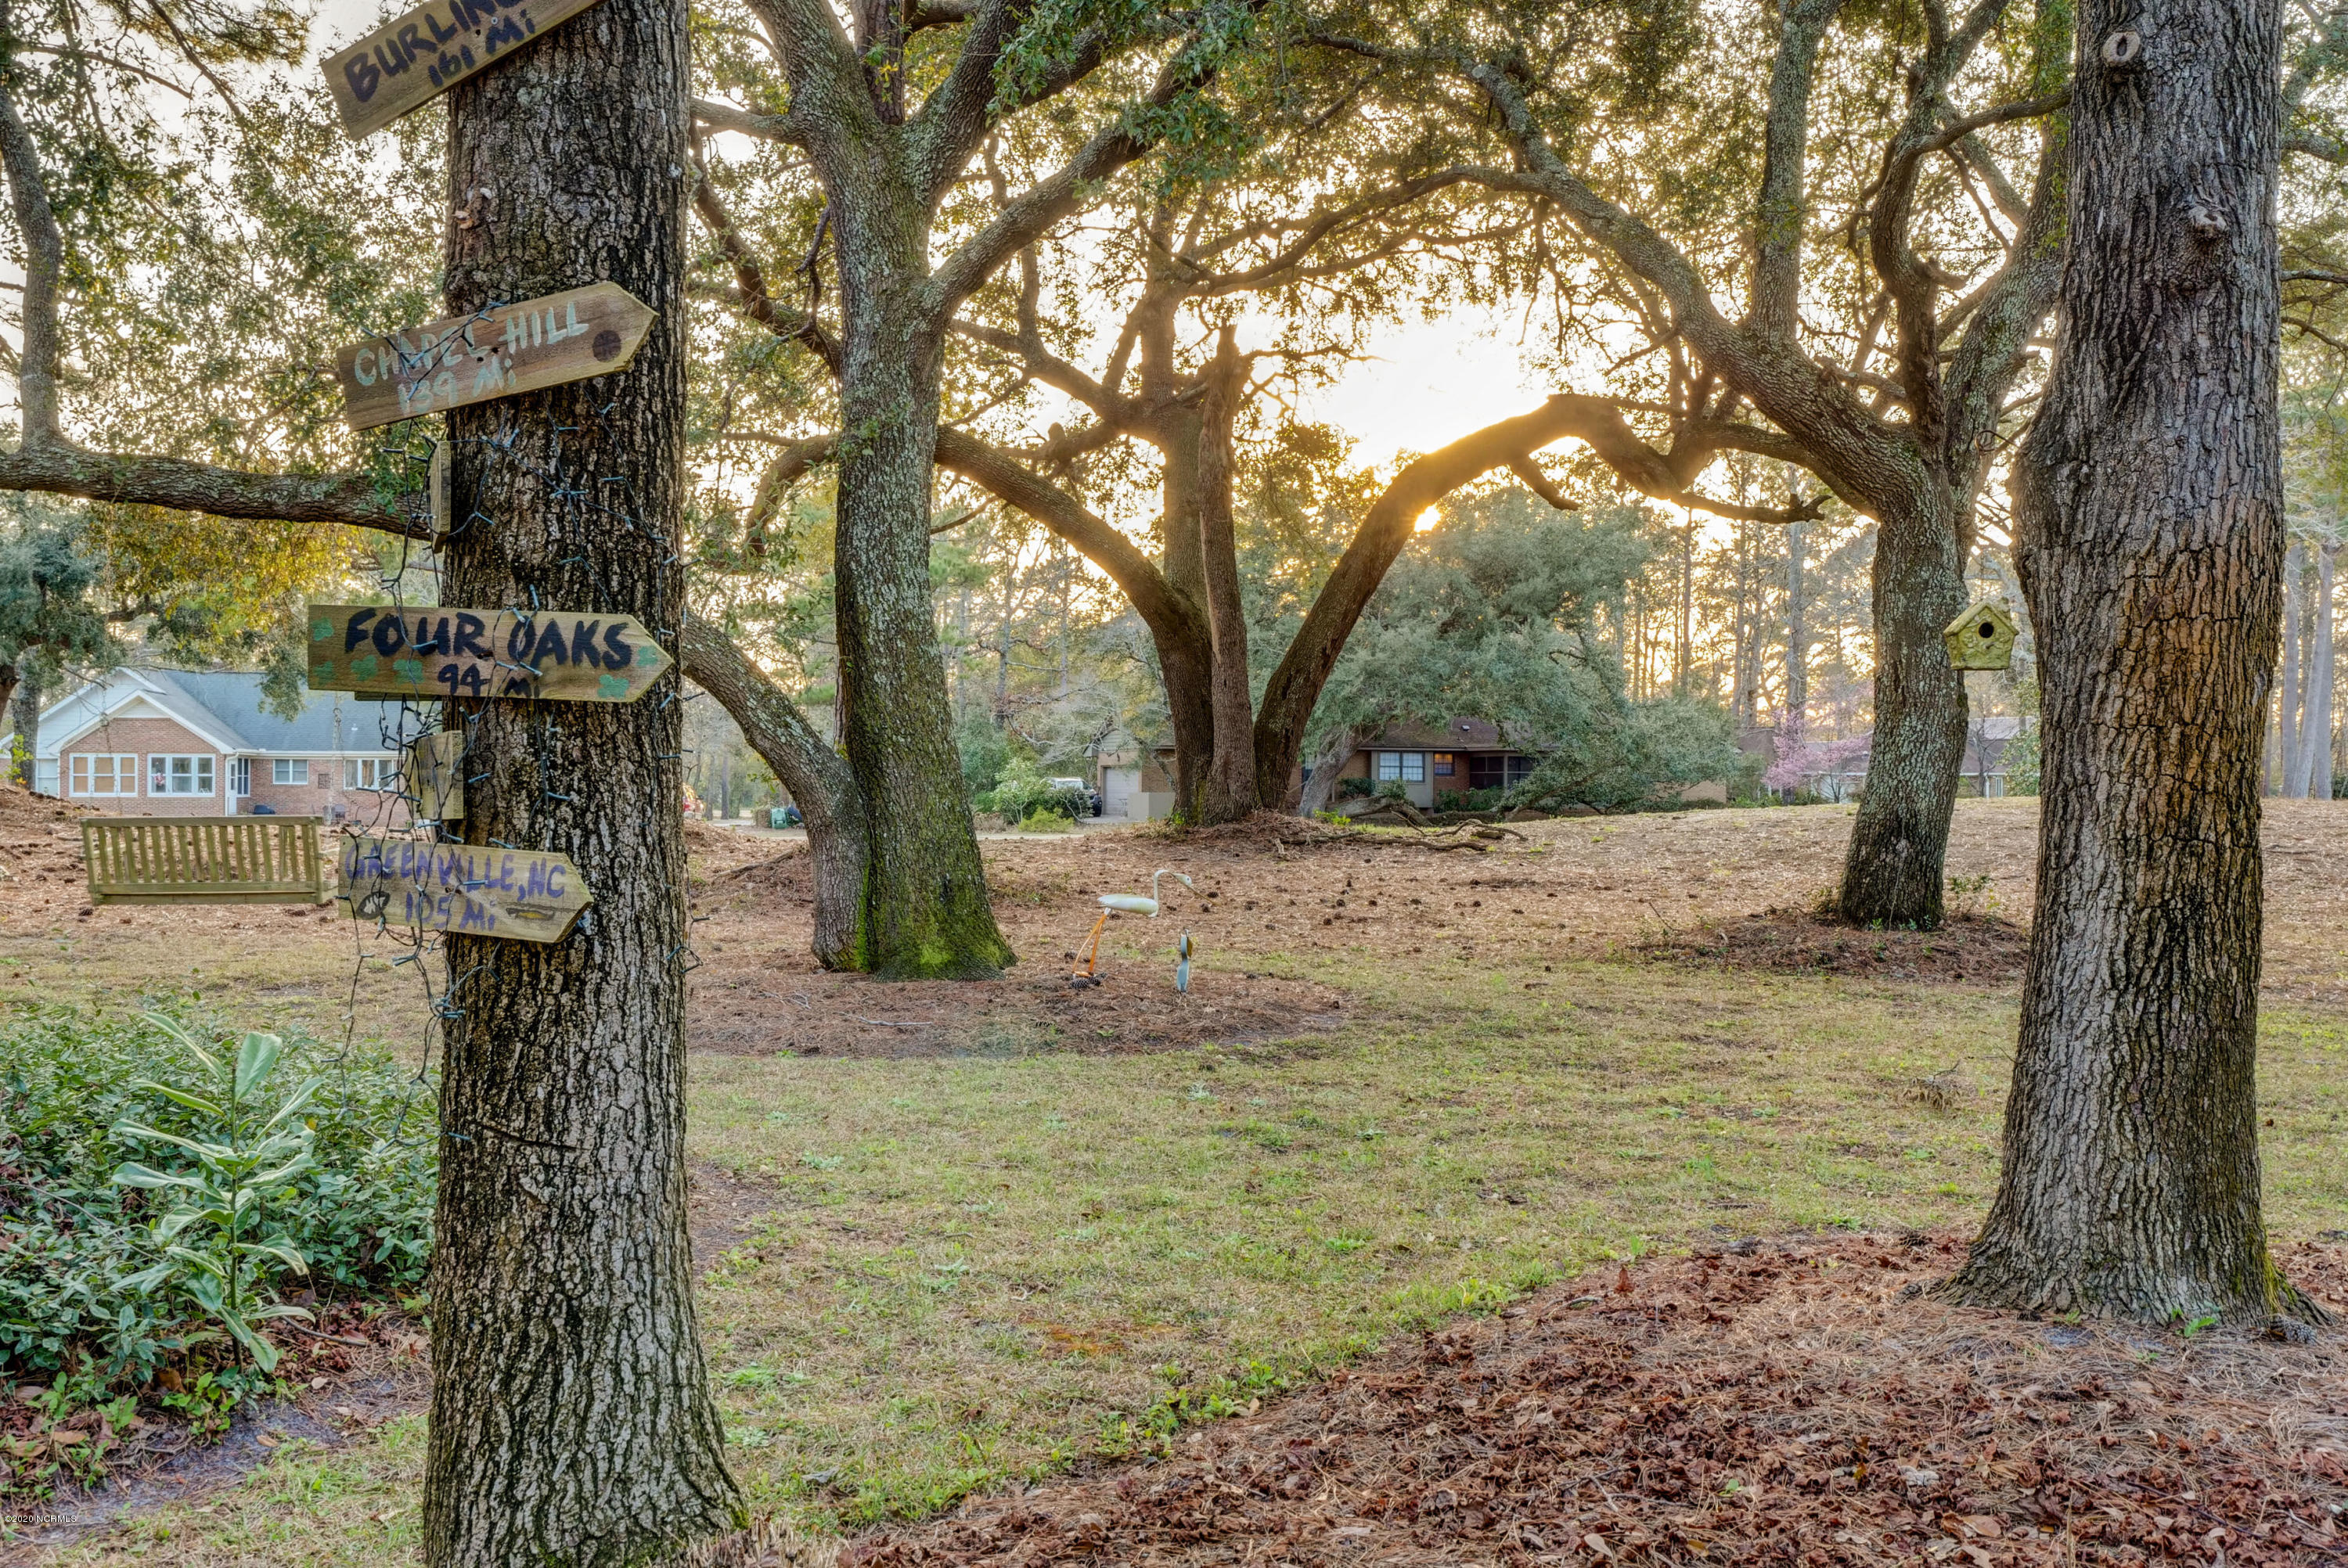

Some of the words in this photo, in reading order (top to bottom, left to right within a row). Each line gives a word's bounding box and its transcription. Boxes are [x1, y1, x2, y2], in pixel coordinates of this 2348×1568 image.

[355, 323, 492, 387] CHAPEL
[499, 302, 589, 354] HILL
[344, 608, 487, 656] FOUR
[507, 615, 632, 671] OAKS
[438, 663, 489, 696] 94
